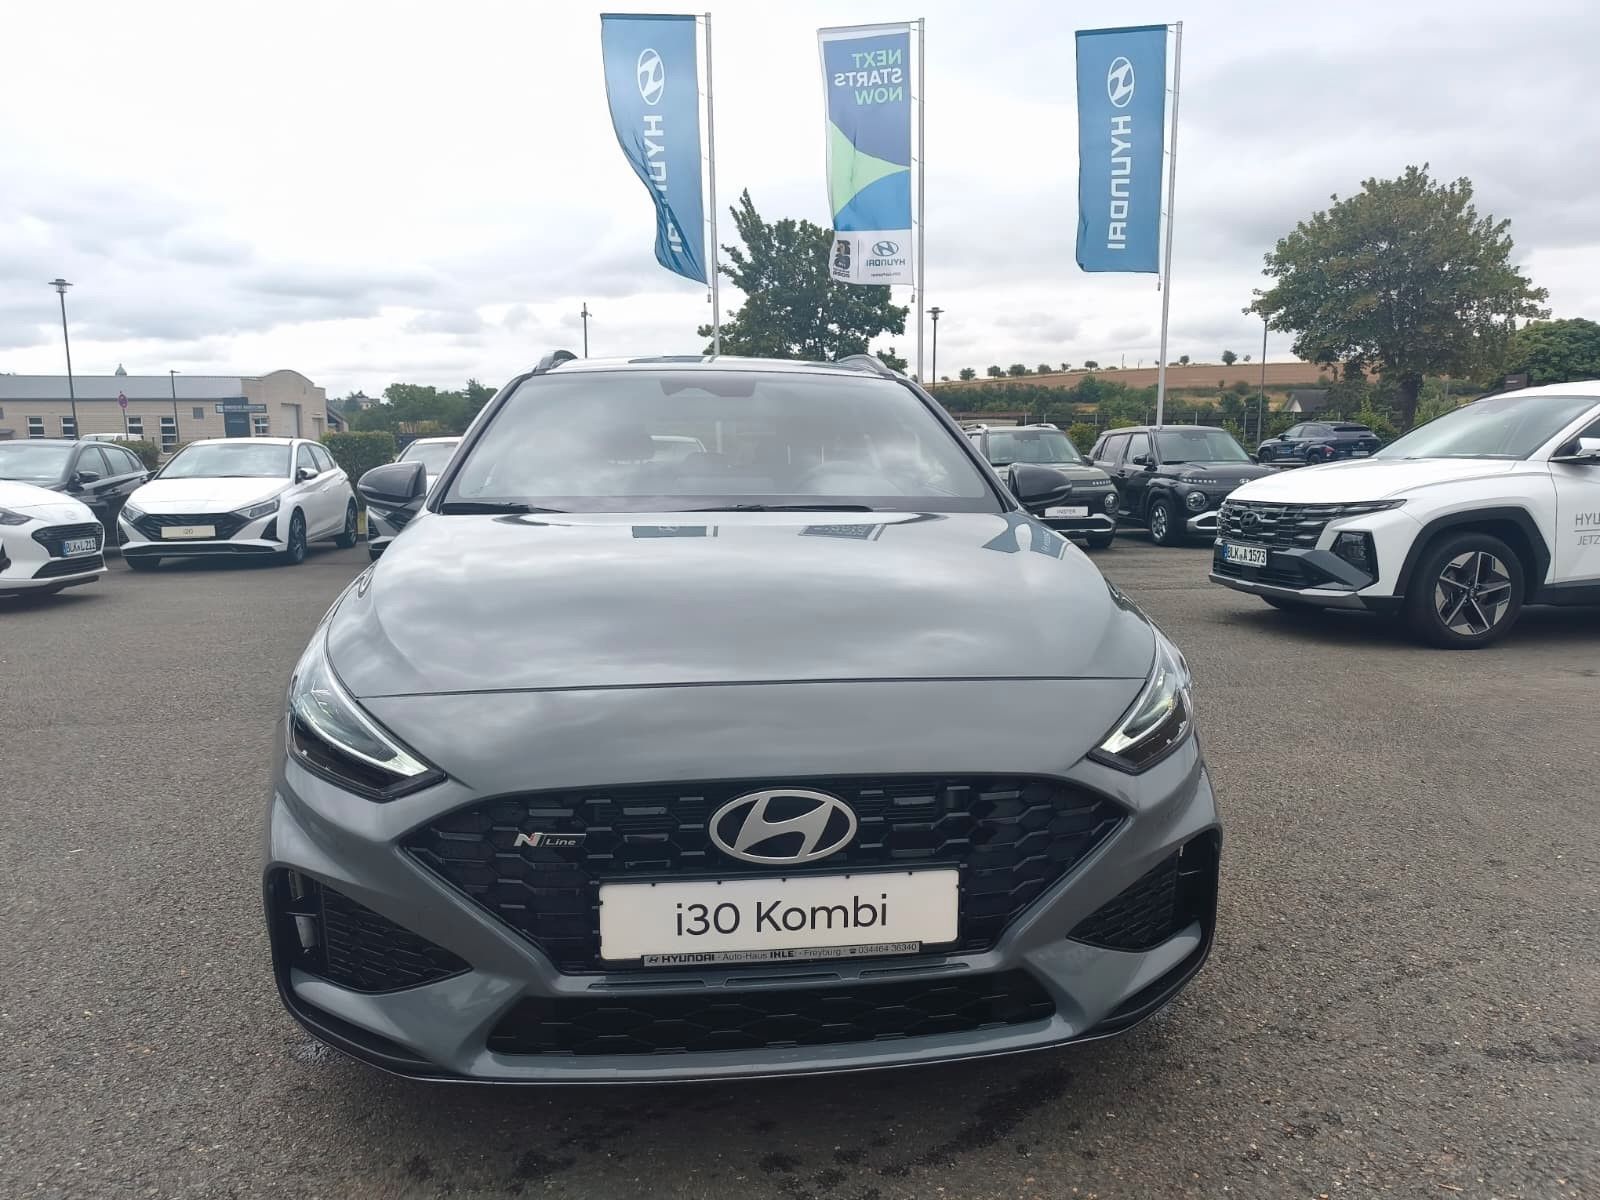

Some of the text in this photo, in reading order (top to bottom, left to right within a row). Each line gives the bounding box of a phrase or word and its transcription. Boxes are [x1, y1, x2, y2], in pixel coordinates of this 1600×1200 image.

[545, 838, 576, 846] Line
[676, 893, 887, 936] i30 Kombi
[662, 953, 715, 964] HYUNDAI
[722, 951, 768, 962] Auto-Haus
[770, 949, 794, 960] IHLE
[804, 949, 841, 958] Freyburg
